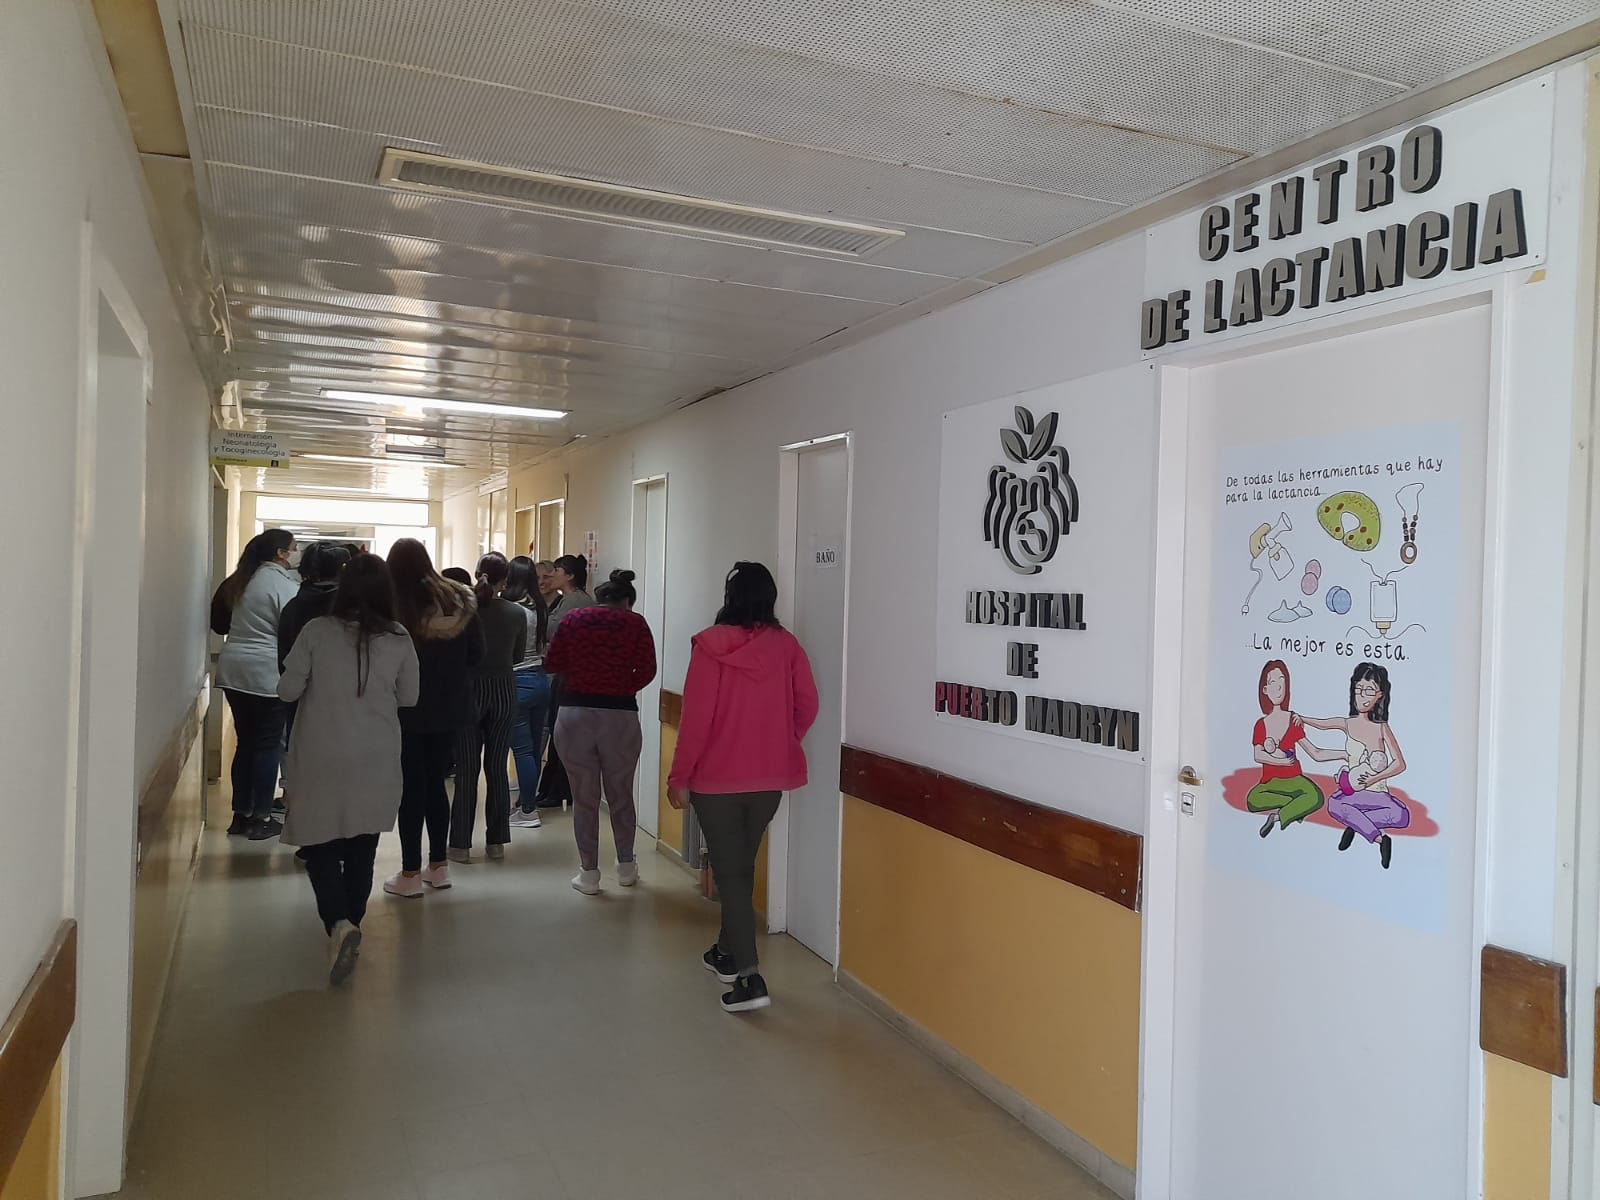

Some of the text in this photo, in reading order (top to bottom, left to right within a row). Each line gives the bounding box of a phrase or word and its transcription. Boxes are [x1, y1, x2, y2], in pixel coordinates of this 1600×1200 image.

[1199, 124, 1443, 262] CENTRO
[1140, 187, 1529, 350] DE LACTANCIA
[1226, 456, 1443, 487] De todas las herramientas que hay
[1225, 492, 1249, 505] para
[1253, 489, 1263, 501] la
[816, 548, 835, 563] BAÑO
[965, 590, 1087, 631] HOSPITAL
[1006, 641, 1039, 679] DE
[1280, 635, 1326, 657] mejor
[1335, 641, 1354, 657] es
[1363, 642, 1410, 661] esta.
[934, 681, 1140, 752] PUERTO MADRYN
